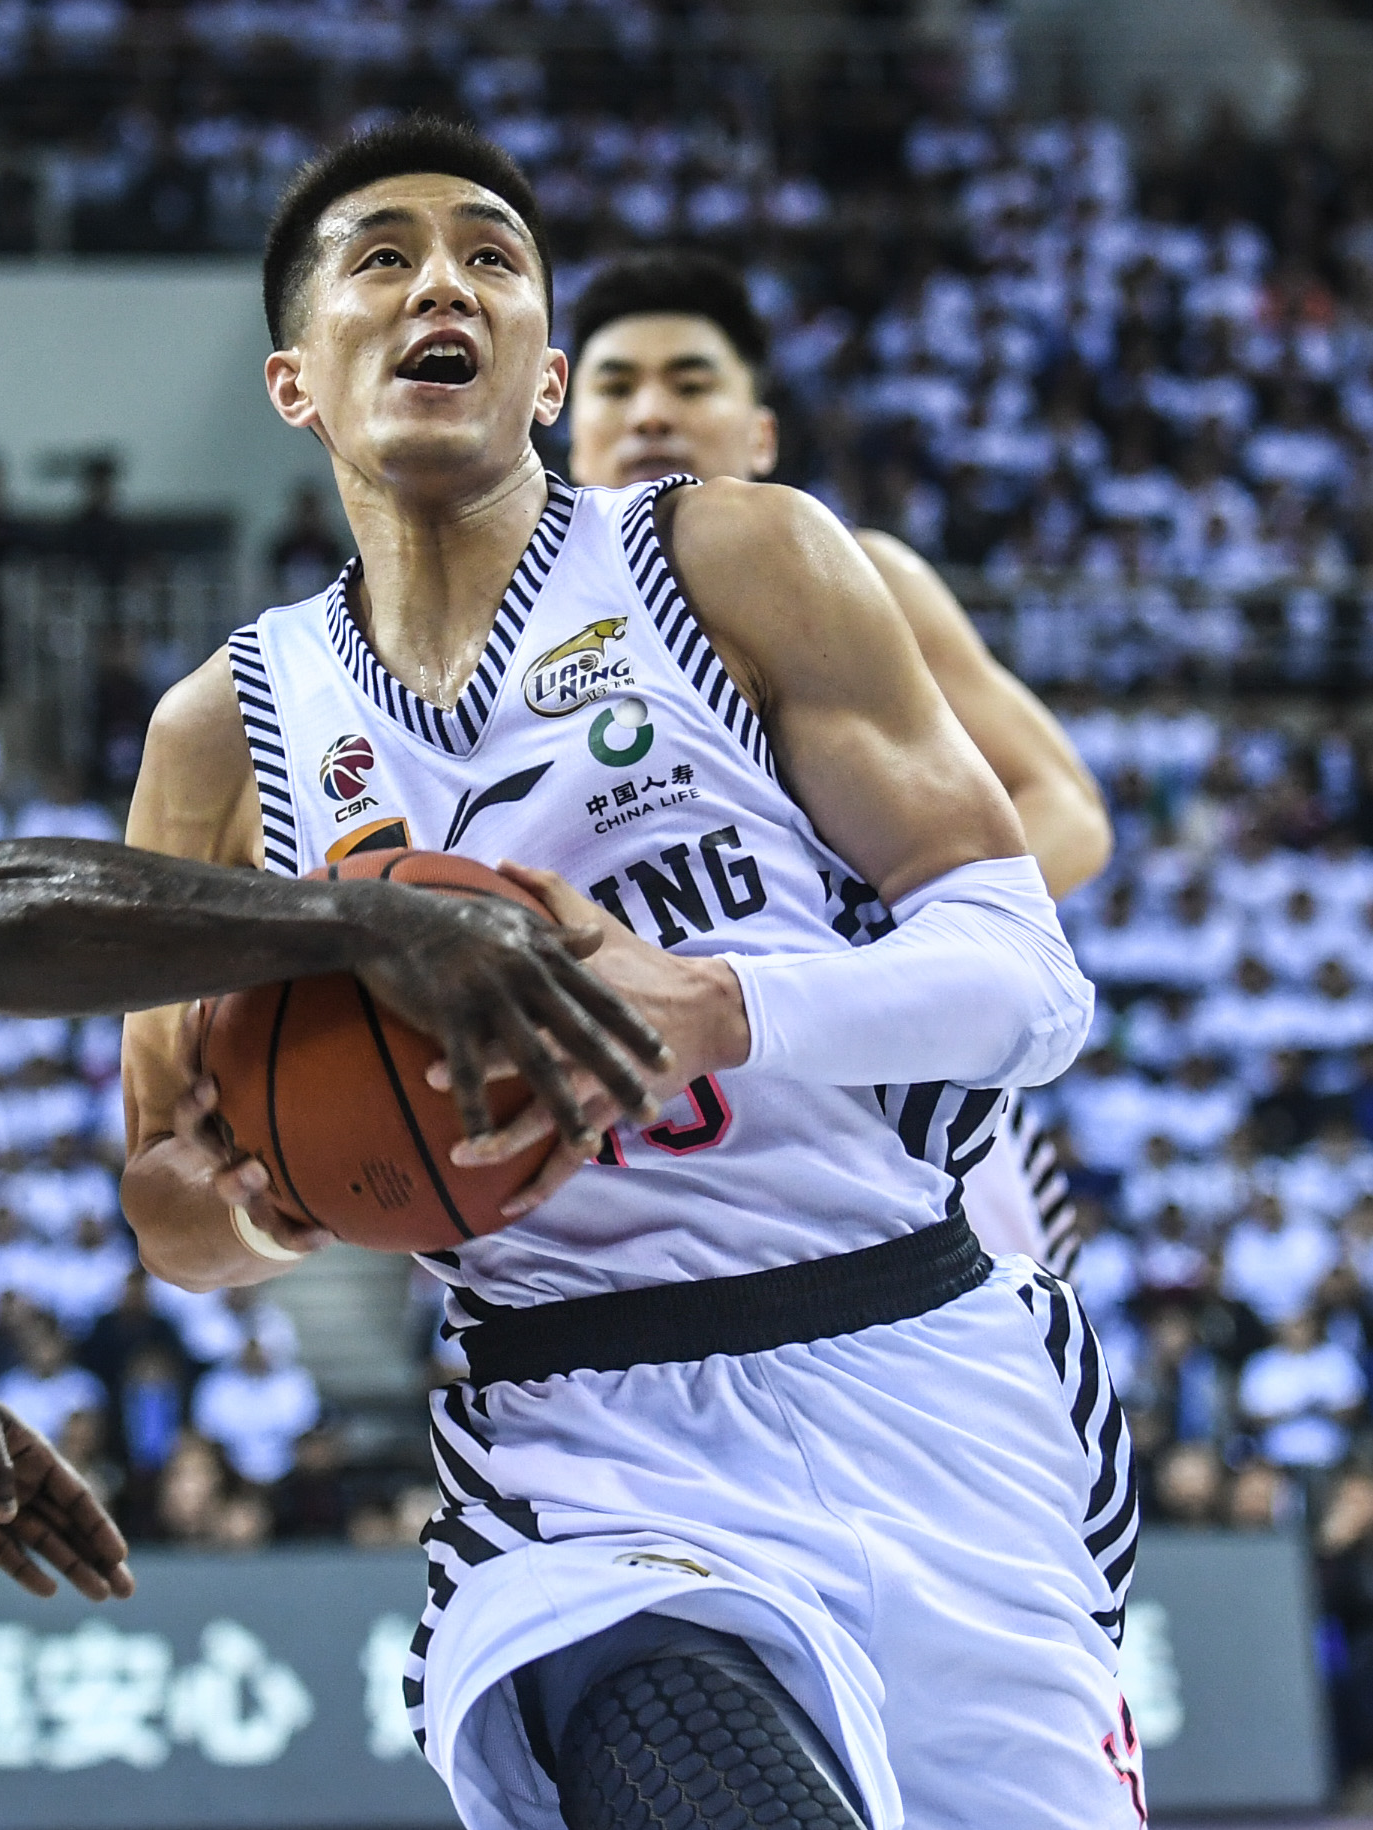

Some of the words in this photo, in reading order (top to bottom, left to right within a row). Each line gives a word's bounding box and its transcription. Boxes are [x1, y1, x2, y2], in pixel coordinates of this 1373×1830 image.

[559, 657, 630, 703] NING
[335, 796, 380, 823] CBA
[585, 764, 694, 817] 中国人寿
[594, 803, 655, 834] CHINA
[660, 787, 701, 808] LIFE
